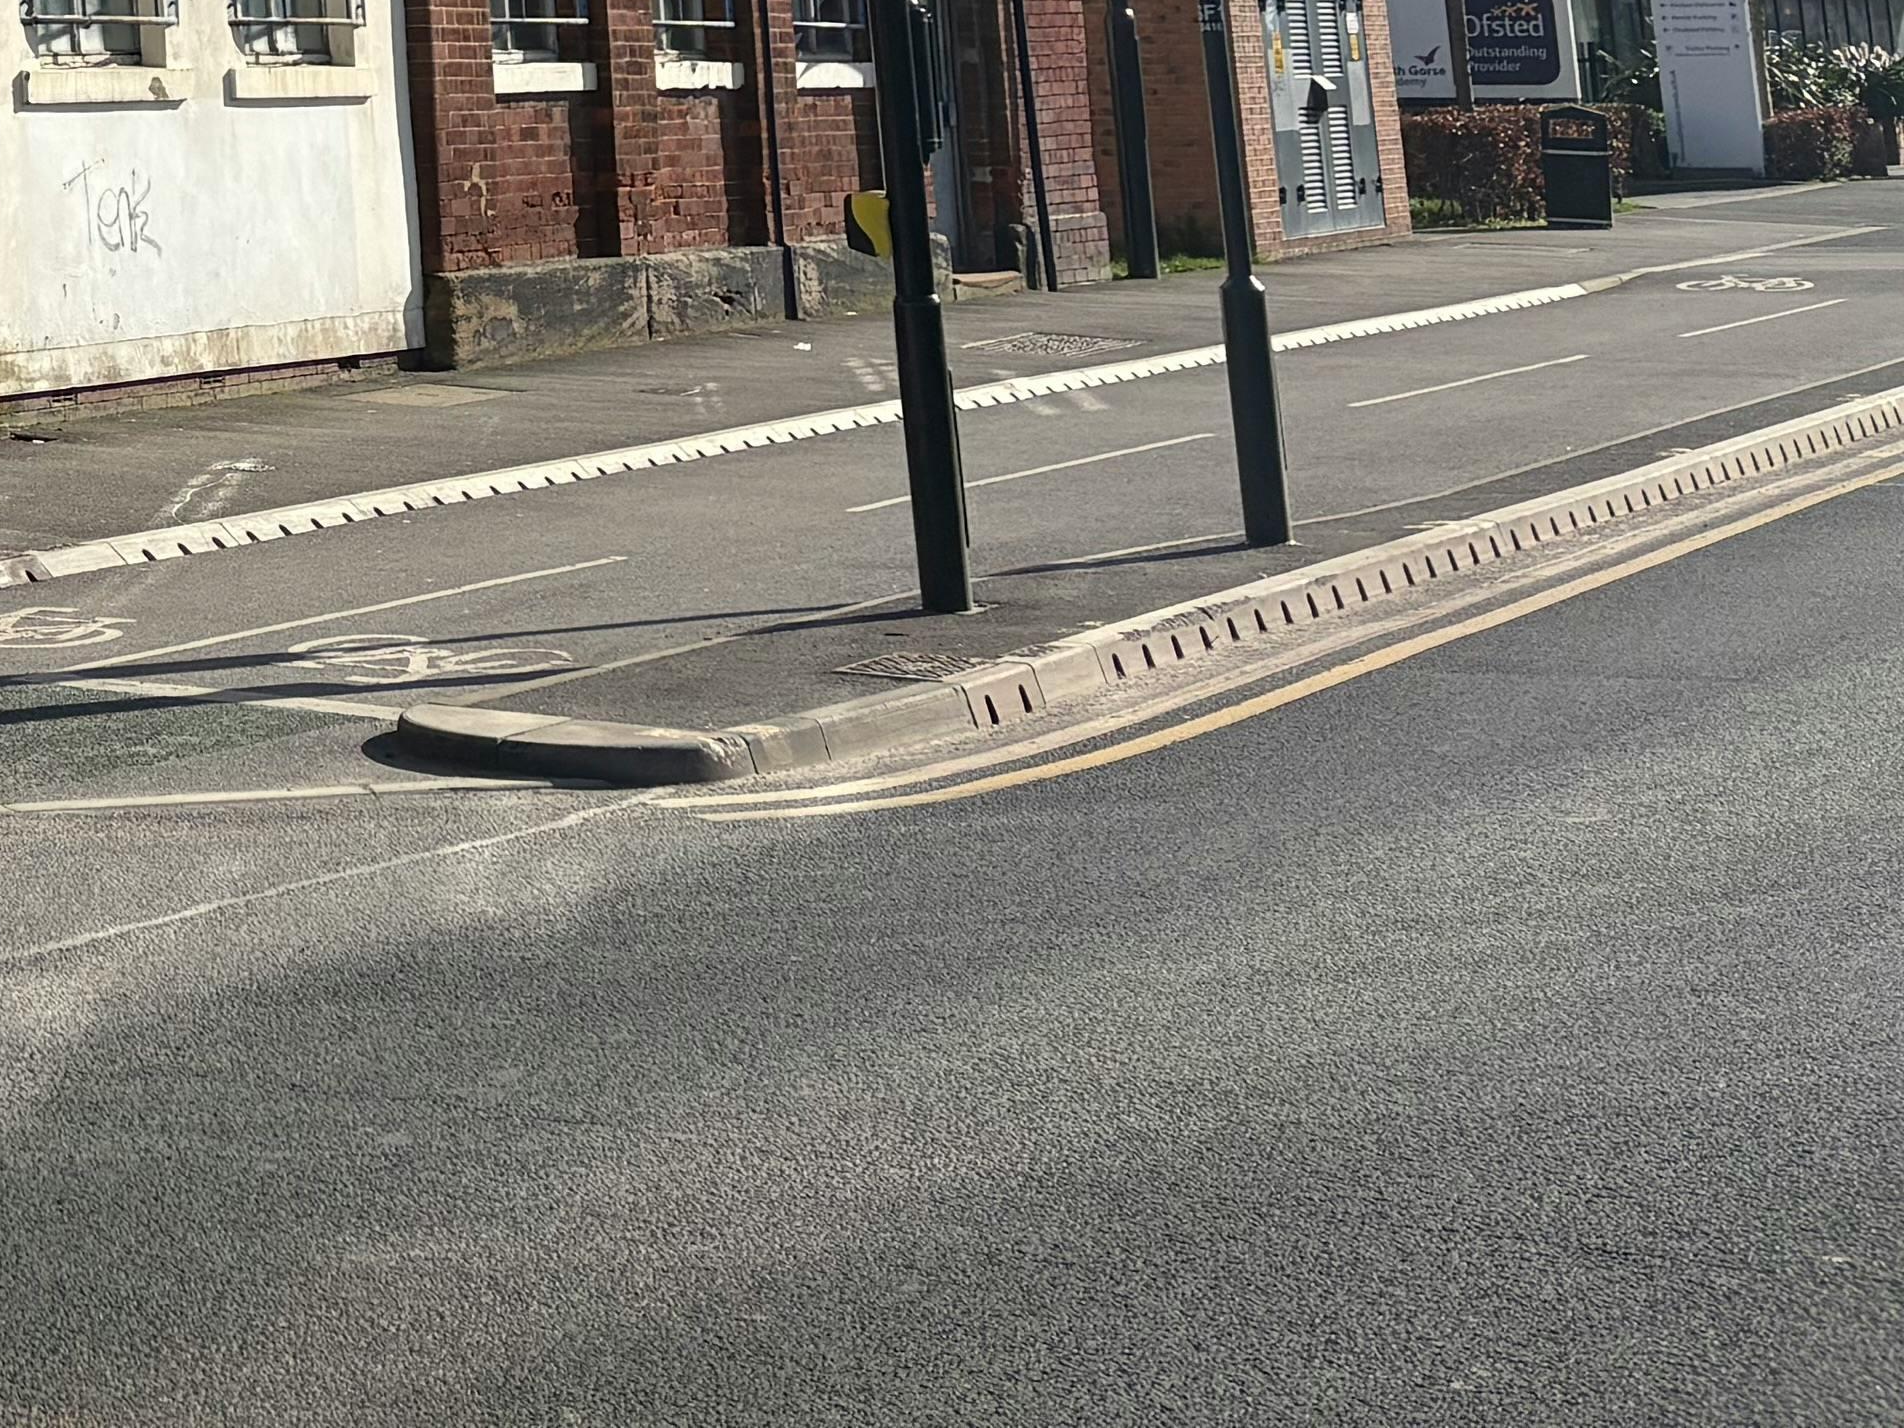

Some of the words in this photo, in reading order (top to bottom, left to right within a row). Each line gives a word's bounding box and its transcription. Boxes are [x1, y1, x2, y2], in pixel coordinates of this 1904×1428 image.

[1465, 15, 1545, 37] Ofsted
[1467, 46, 1547, 60] Outstanding
[1408, 65, 1446, 76] Gorse
